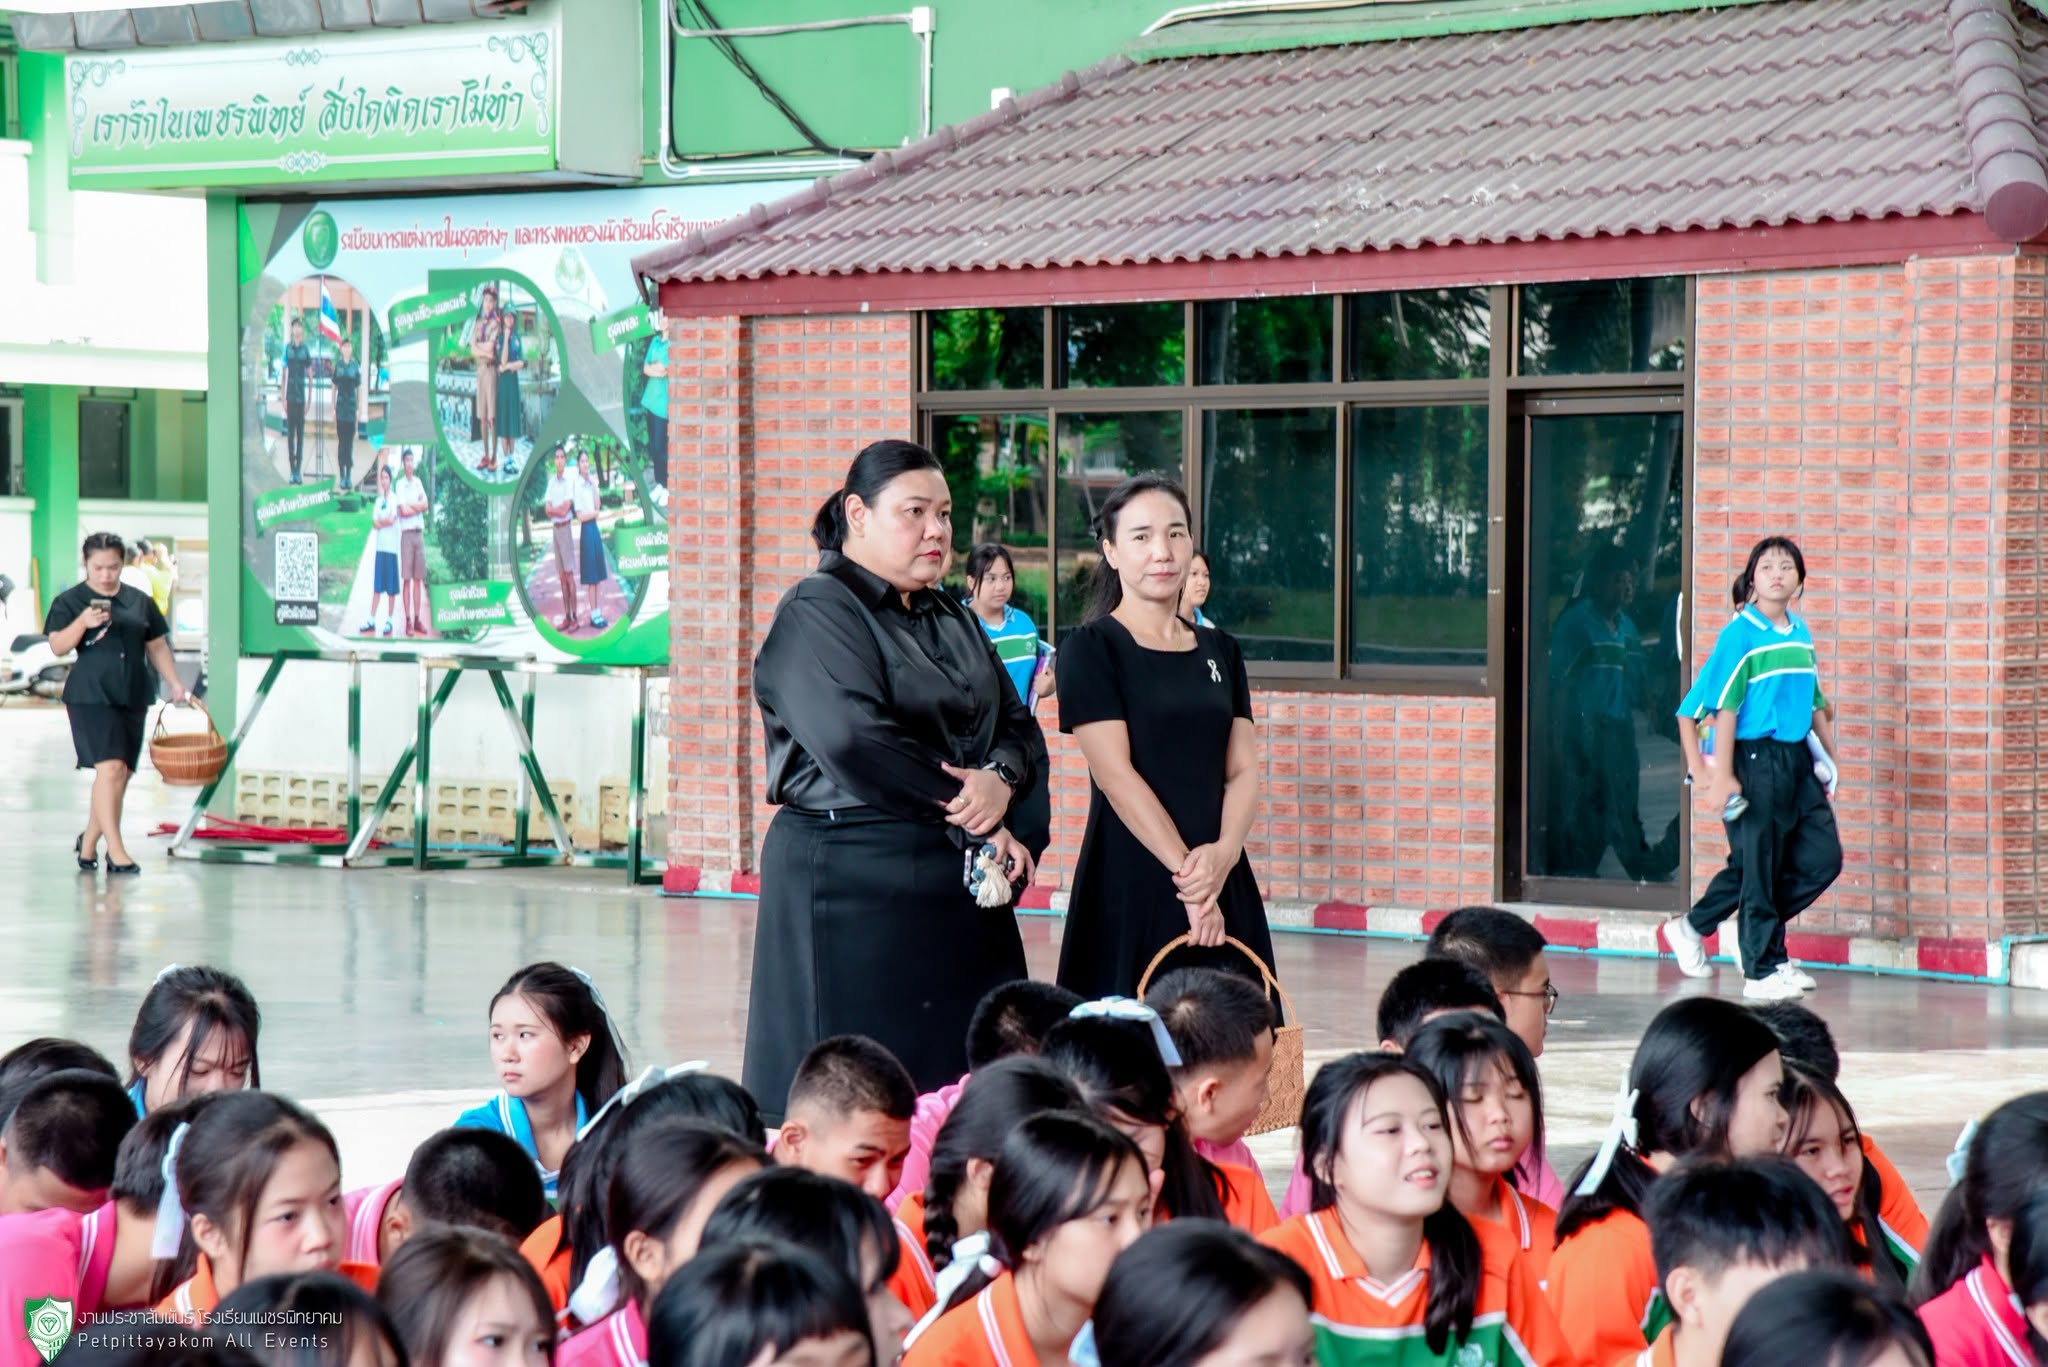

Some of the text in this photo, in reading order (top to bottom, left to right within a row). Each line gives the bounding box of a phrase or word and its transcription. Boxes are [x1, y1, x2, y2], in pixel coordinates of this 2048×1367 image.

[318, 76, 524, 138] สิ่งใดผิดเราไม่ทำ
